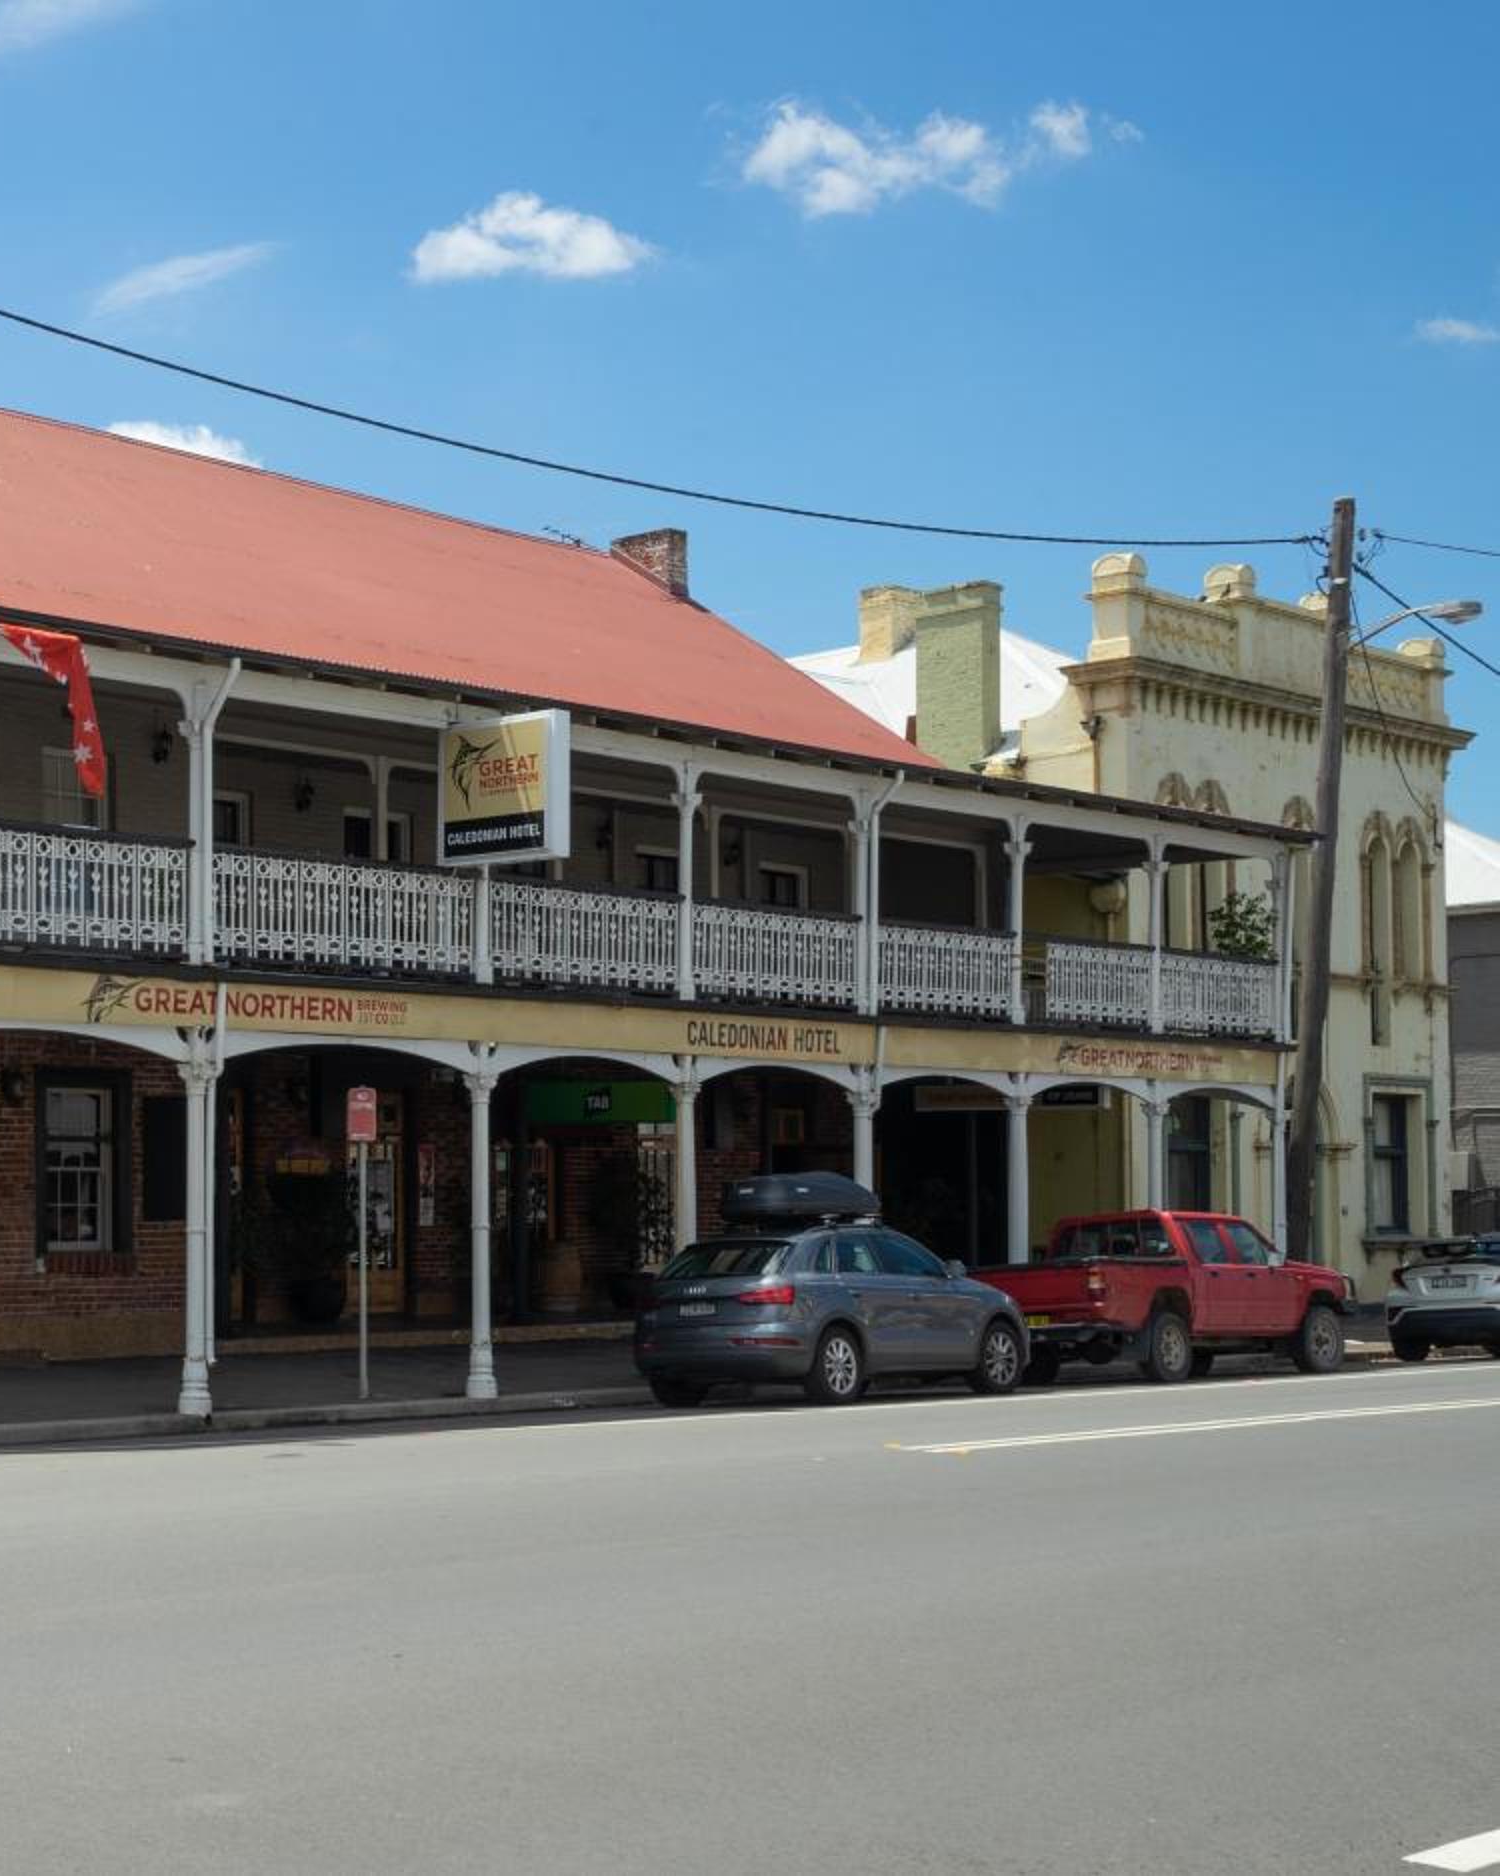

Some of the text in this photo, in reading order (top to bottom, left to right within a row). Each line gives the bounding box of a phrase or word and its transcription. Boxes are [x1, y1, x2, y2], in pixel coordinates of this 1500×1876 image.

[480, 753, 538, 777] GREAT
[479, 770, 539, 789] NORTHERN
[447, 823, 541, 847] CALEDONIAN HOTEL
[134, 986, 353, 1022] GREAT NORTHERN
[687, 1020, 841, 1054] CALEDONIAN HOTEL
[1081, 1048, 1126, 1068] GREAT
[588, 1095, 609, 1110] TAB
